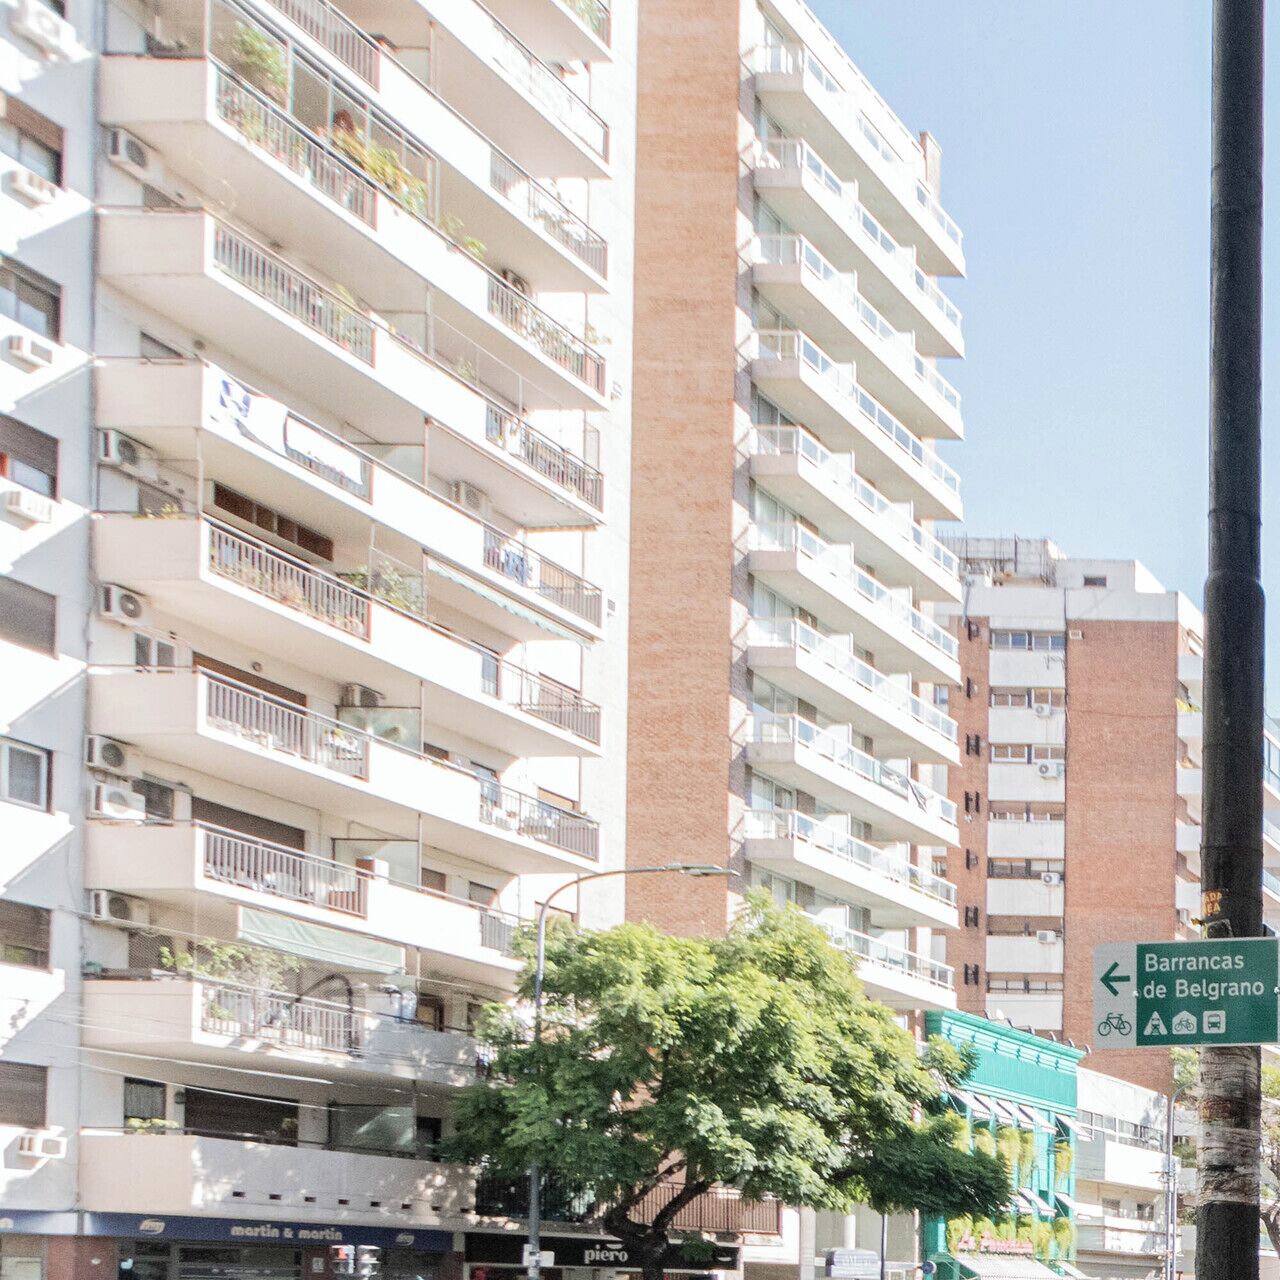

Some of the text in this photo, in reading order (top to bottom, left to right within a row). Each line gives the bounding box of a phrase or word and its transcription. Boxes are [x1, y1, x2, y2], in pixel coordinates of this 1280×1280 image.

[1144, 953, 1245, 972] Barrancas
[1143, 979, 1265, 1000] de Belgrano
[230, 1223, 343, 1241] martin & martin
[584, 1244, 628, 1264] piero
